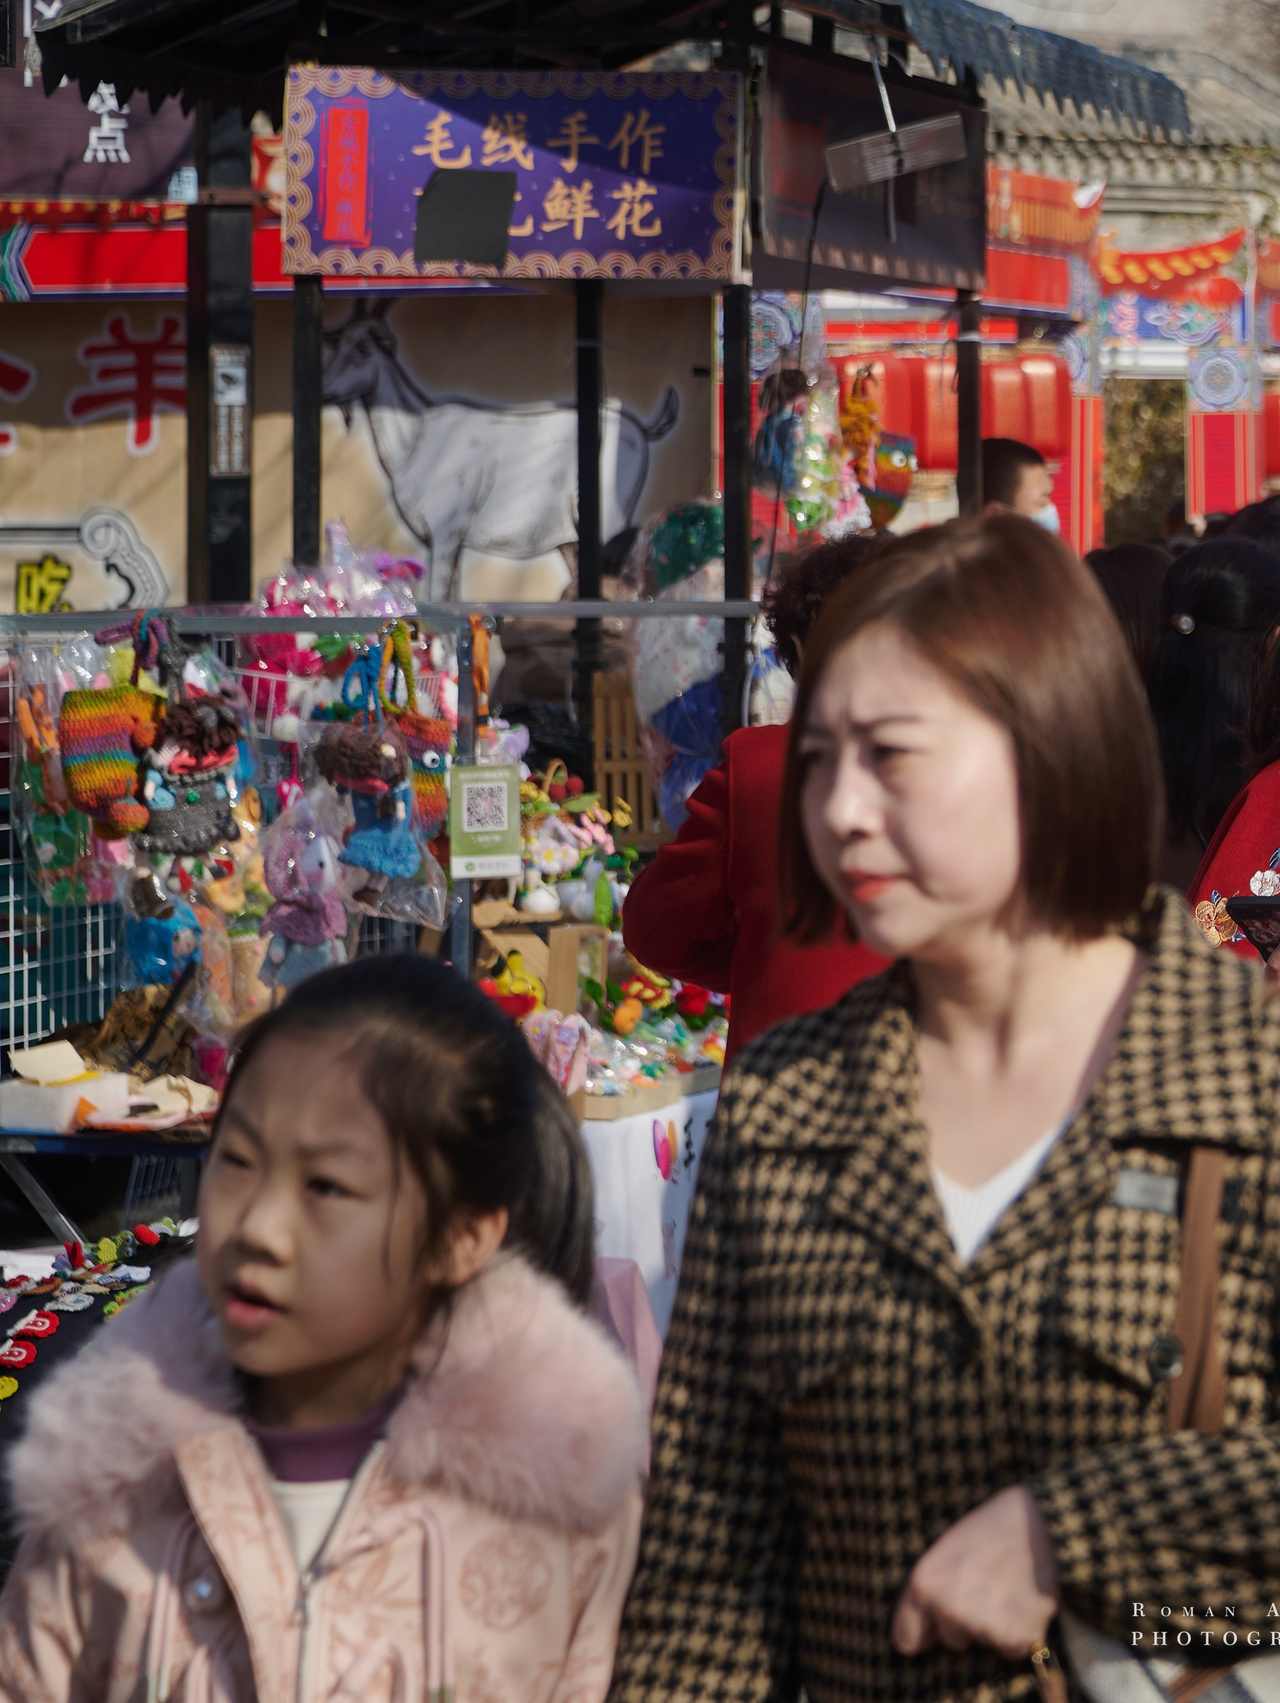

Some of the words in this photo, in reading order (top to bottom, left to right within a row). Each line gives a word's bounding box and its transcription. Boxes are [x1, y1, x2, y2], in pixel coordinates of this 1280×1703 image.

[411, 107, 666, 174] 毛线手作
[412, 177, 662, 240] 鲜花
